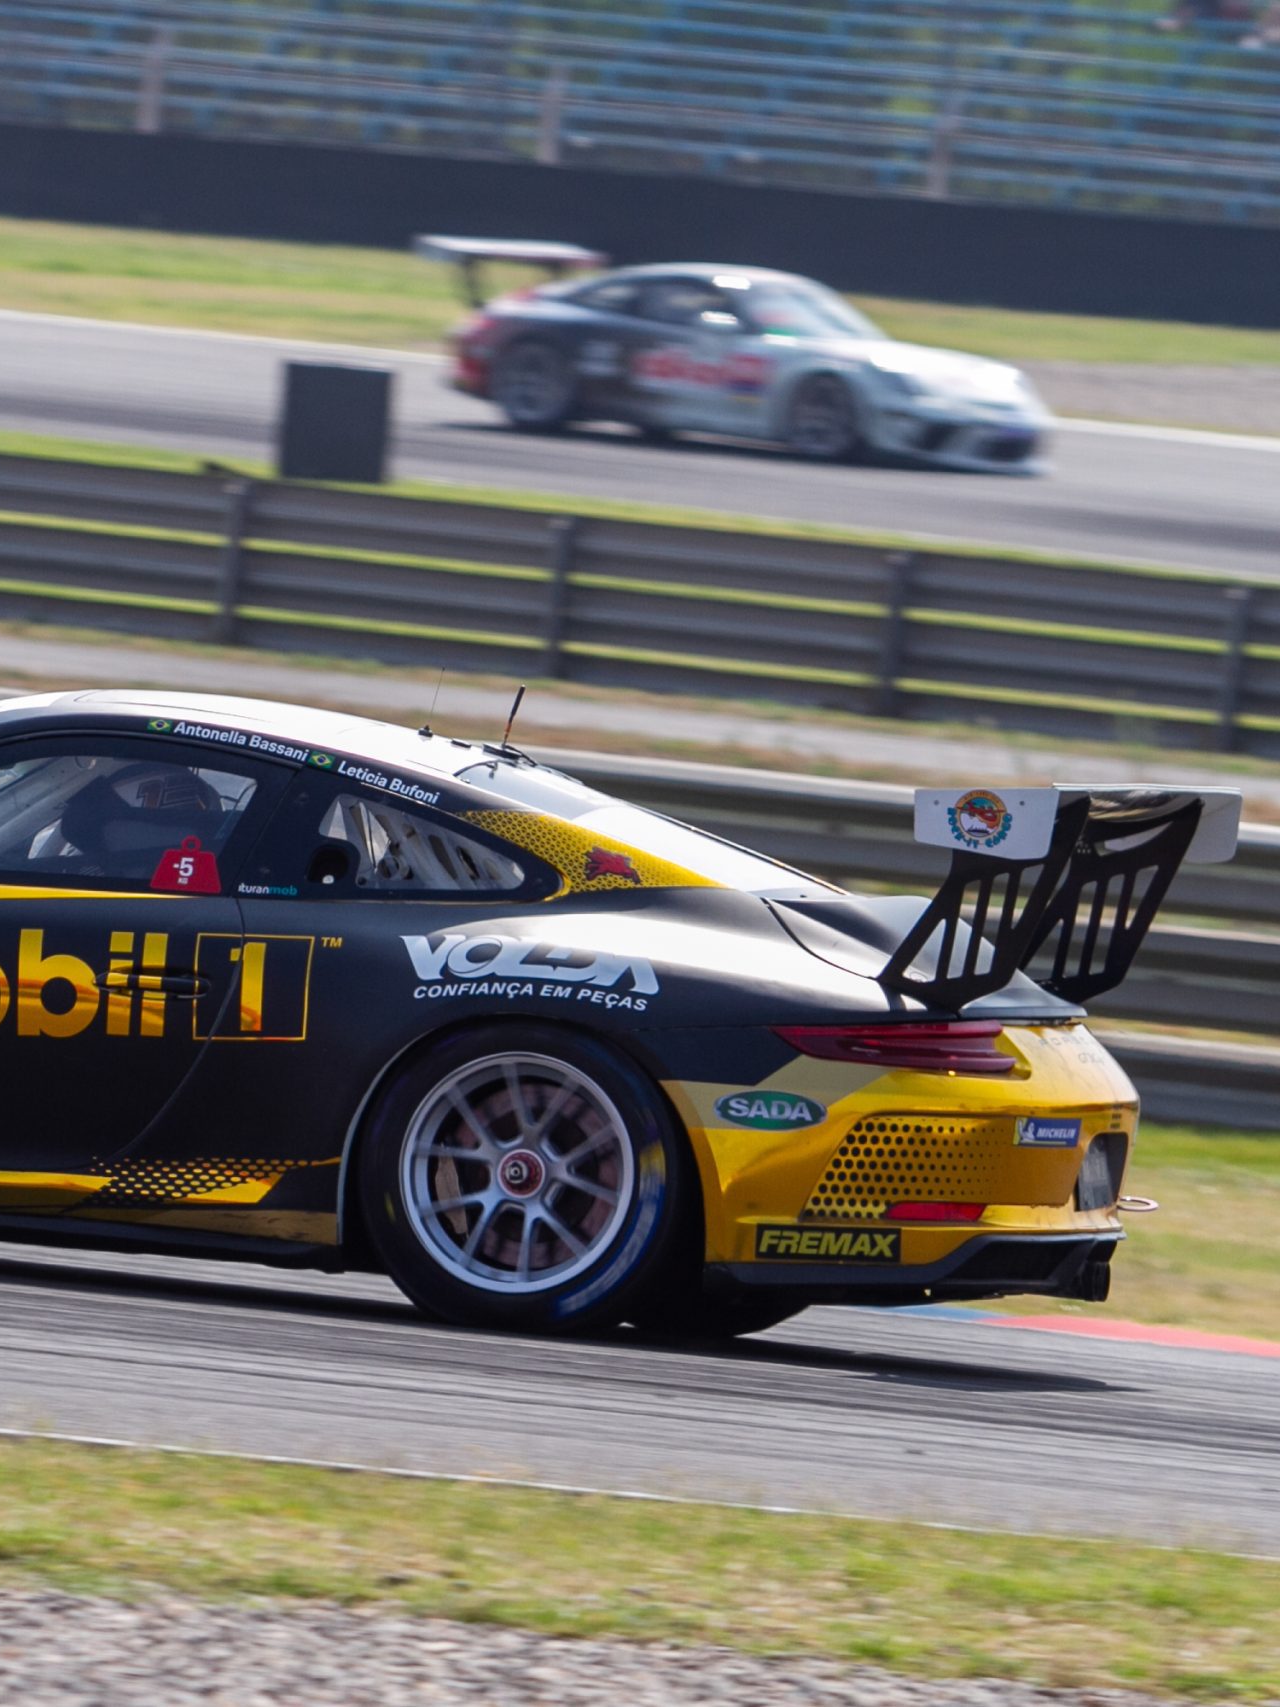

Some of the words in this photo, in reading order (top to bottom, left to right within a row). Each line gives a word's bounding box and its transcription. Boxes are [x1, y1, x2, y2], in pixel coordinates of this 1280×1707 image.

[173, 721, 246, 746] Antonella
[249, 735, 310, 762] Bassani
[337, 760, 388, 787] Leticia
[389, 778, 440, 805] Bufoni
[230, 942, 266, 1031] 1
[413, 982, 533, 999] CONFIANÇA
[540, 984, 572, 998] EM
[577, 988, 648, 1011] PEÇAS
[727, 1098, 814, 1122] SADA
[1036, 1127, 1077, 1139] MICHELIN
[758, 1230, 897, 1258] FREMAX
